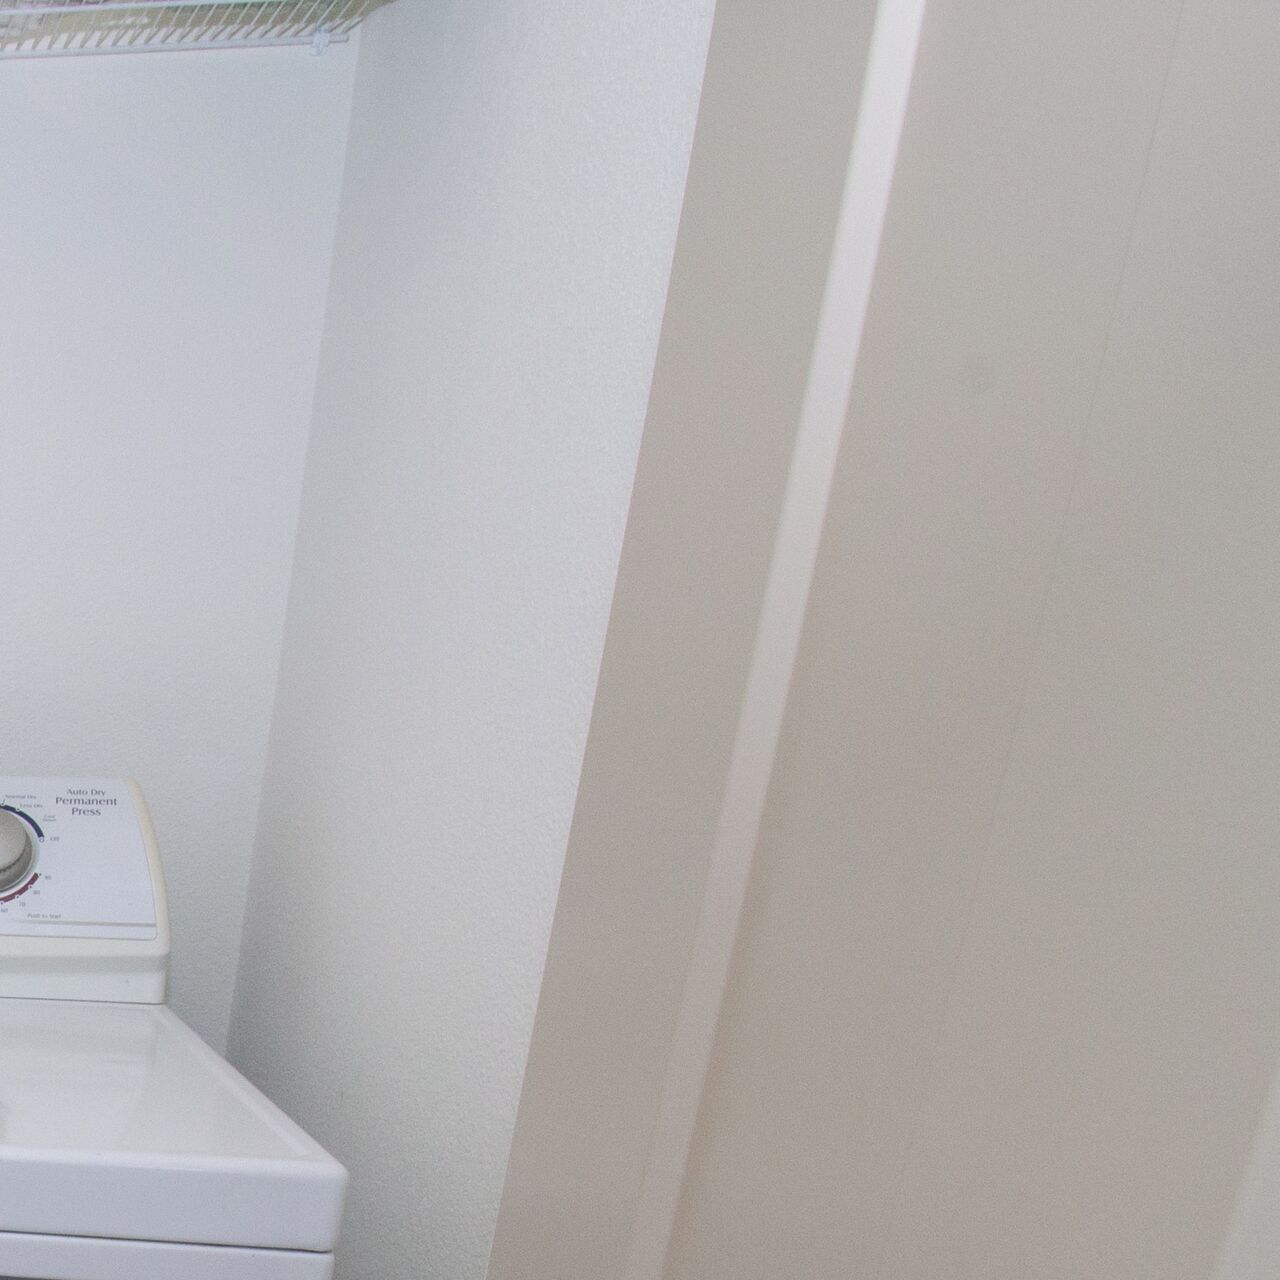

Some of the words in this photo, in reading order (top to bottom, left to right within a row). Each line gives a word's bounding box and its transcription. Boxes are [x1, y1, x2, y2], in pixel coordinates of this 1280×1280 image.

[91, 789, 106, 797] Dry
[55, 797, 117, 806] Permanent
[72, 807, 101, 816] Press
